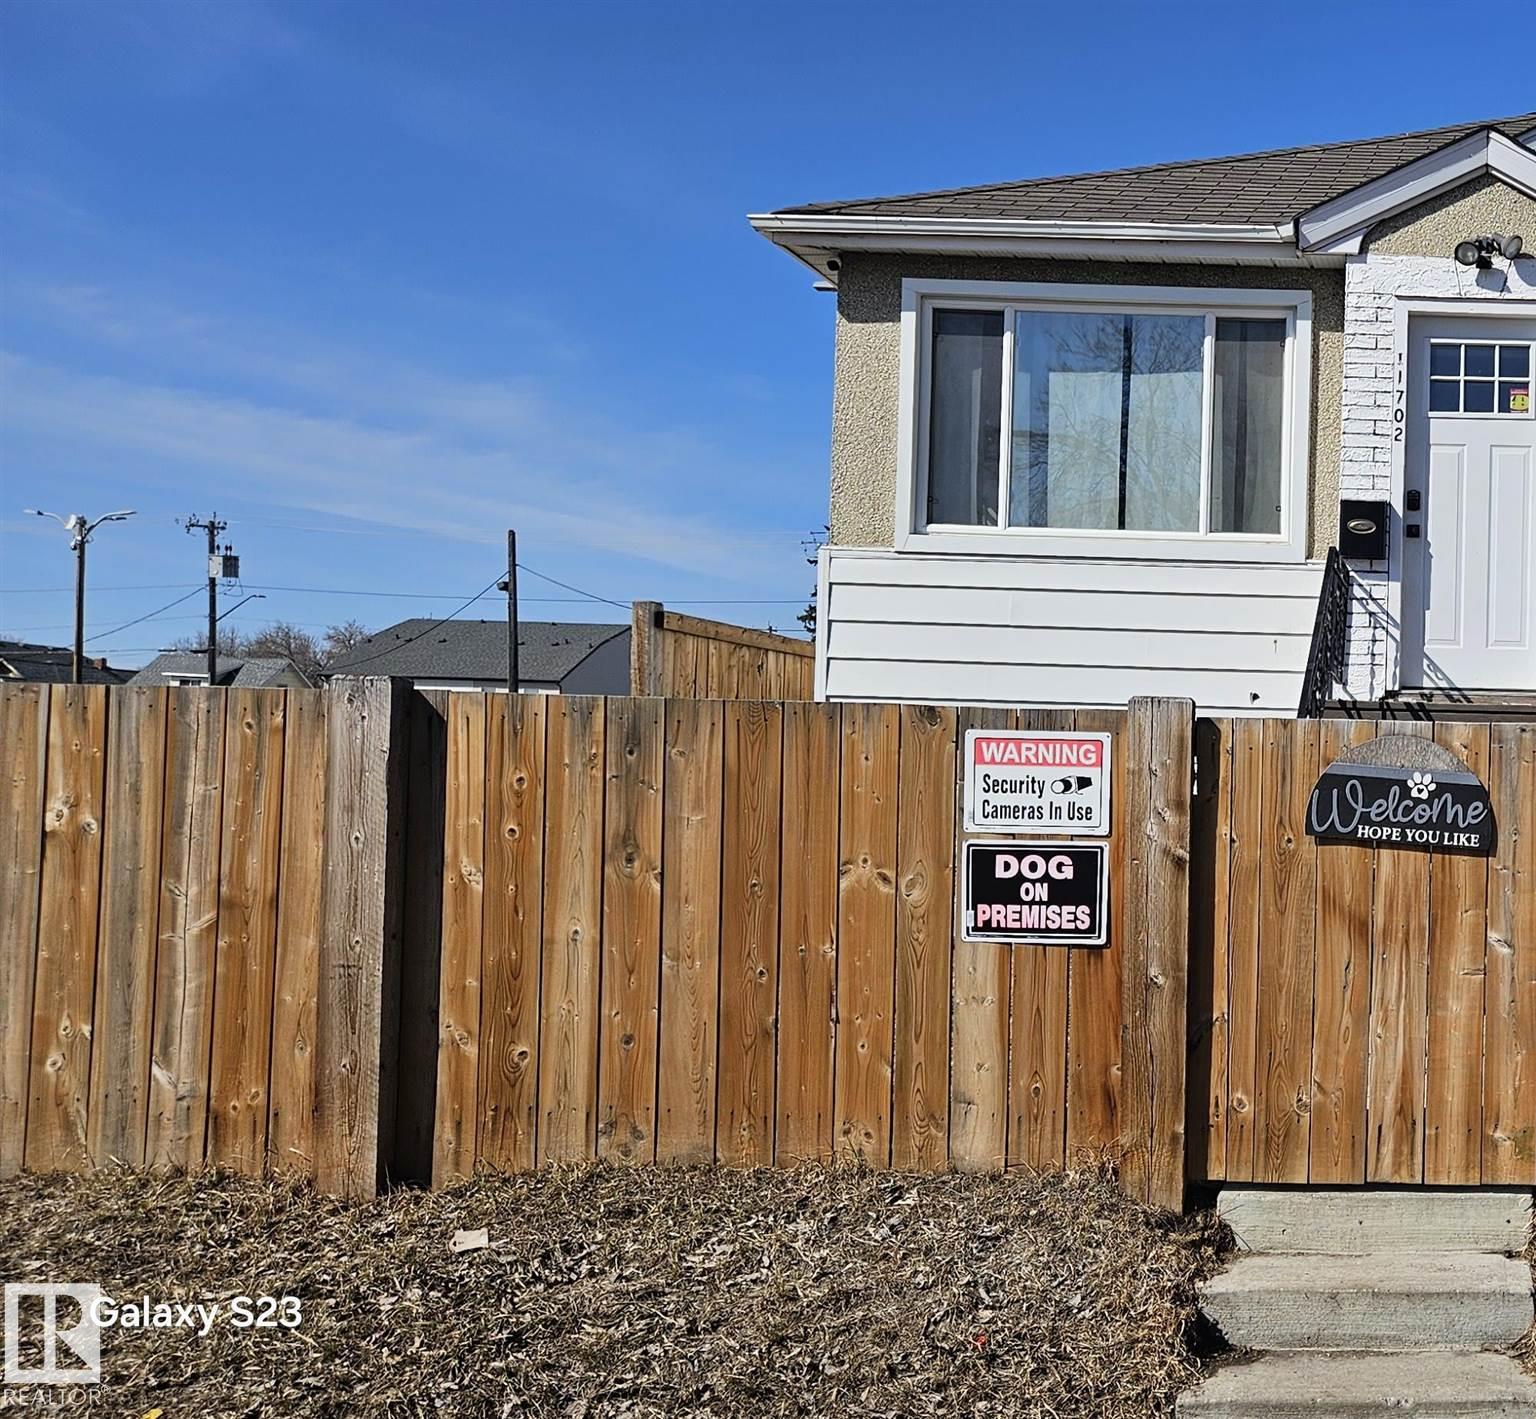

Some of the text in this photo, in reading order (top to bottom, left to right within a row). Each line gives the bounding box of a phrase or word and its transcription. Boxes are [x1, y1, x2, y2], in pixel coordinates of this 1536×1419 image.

[981, 742, 1096, 765] WARNING
[982, 773, 1046, 798] Security
[982, 799, 1093, 821] Cameras In Use
[1311, 779, 1488, 833] Welcome
[1357, 824, 1480, 847] HOPE YOU LIKE
[995, 854, 1074, 879] DOG
[1019, 882, 1048, 901] ON
[976, 904, 1091, 930] PREMISES
